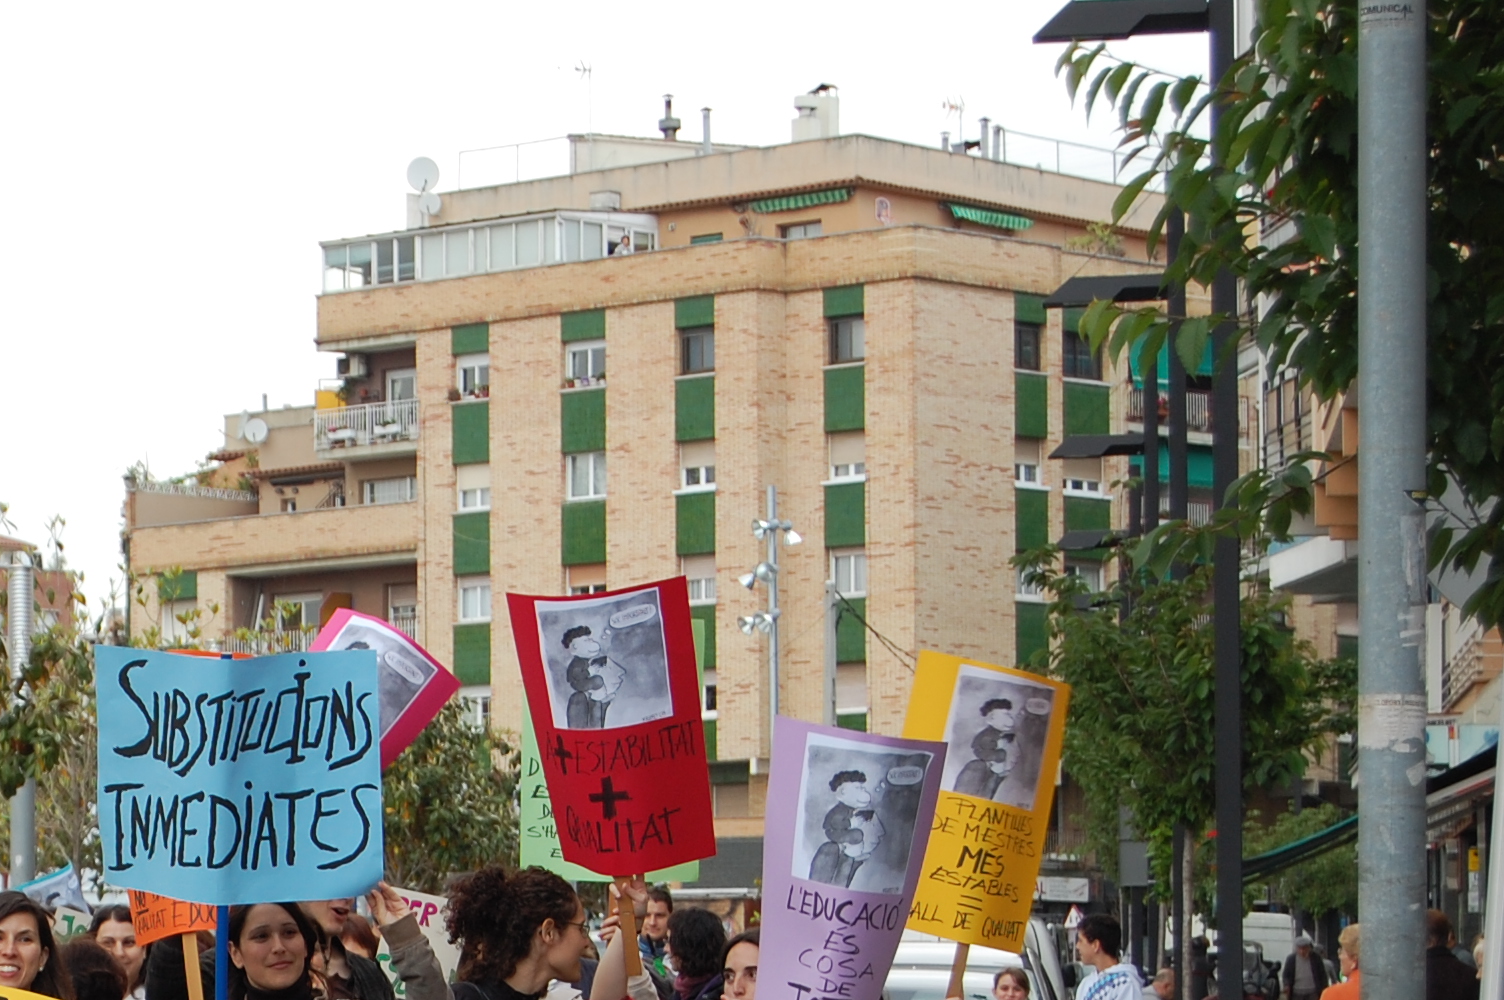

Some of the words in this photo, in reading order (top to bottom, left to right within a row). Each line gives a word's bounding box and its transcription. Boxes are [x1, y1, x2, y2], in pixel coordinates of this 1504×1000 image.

[113, 659, 372, 777] SUBSTITUCIONS
[575, 720, 697, 775] ESTABILITAT
[104, 780, 379, 871] INMEDIATES
[566, 805, 681, 855] QUALITAT
[947, 797, 1033, 836] PLANTILLES
[963, 823, 1036, 858] MESTRES
[956, 845, 1005, 878] MÉS
[929, 866, 1019, 903] ESTABLES
[786, 884, 903, 931] L'EDUCACIÓ
[909, 901, 943, 923] ALL
[953, 910, 974, 930] DE
[982, 916, 1024, 942] QUALITAT
[823, 927, 860, 955] ÉS
[798, 949, 874, 980] COSA
[816, 976, 856, 997] DE
